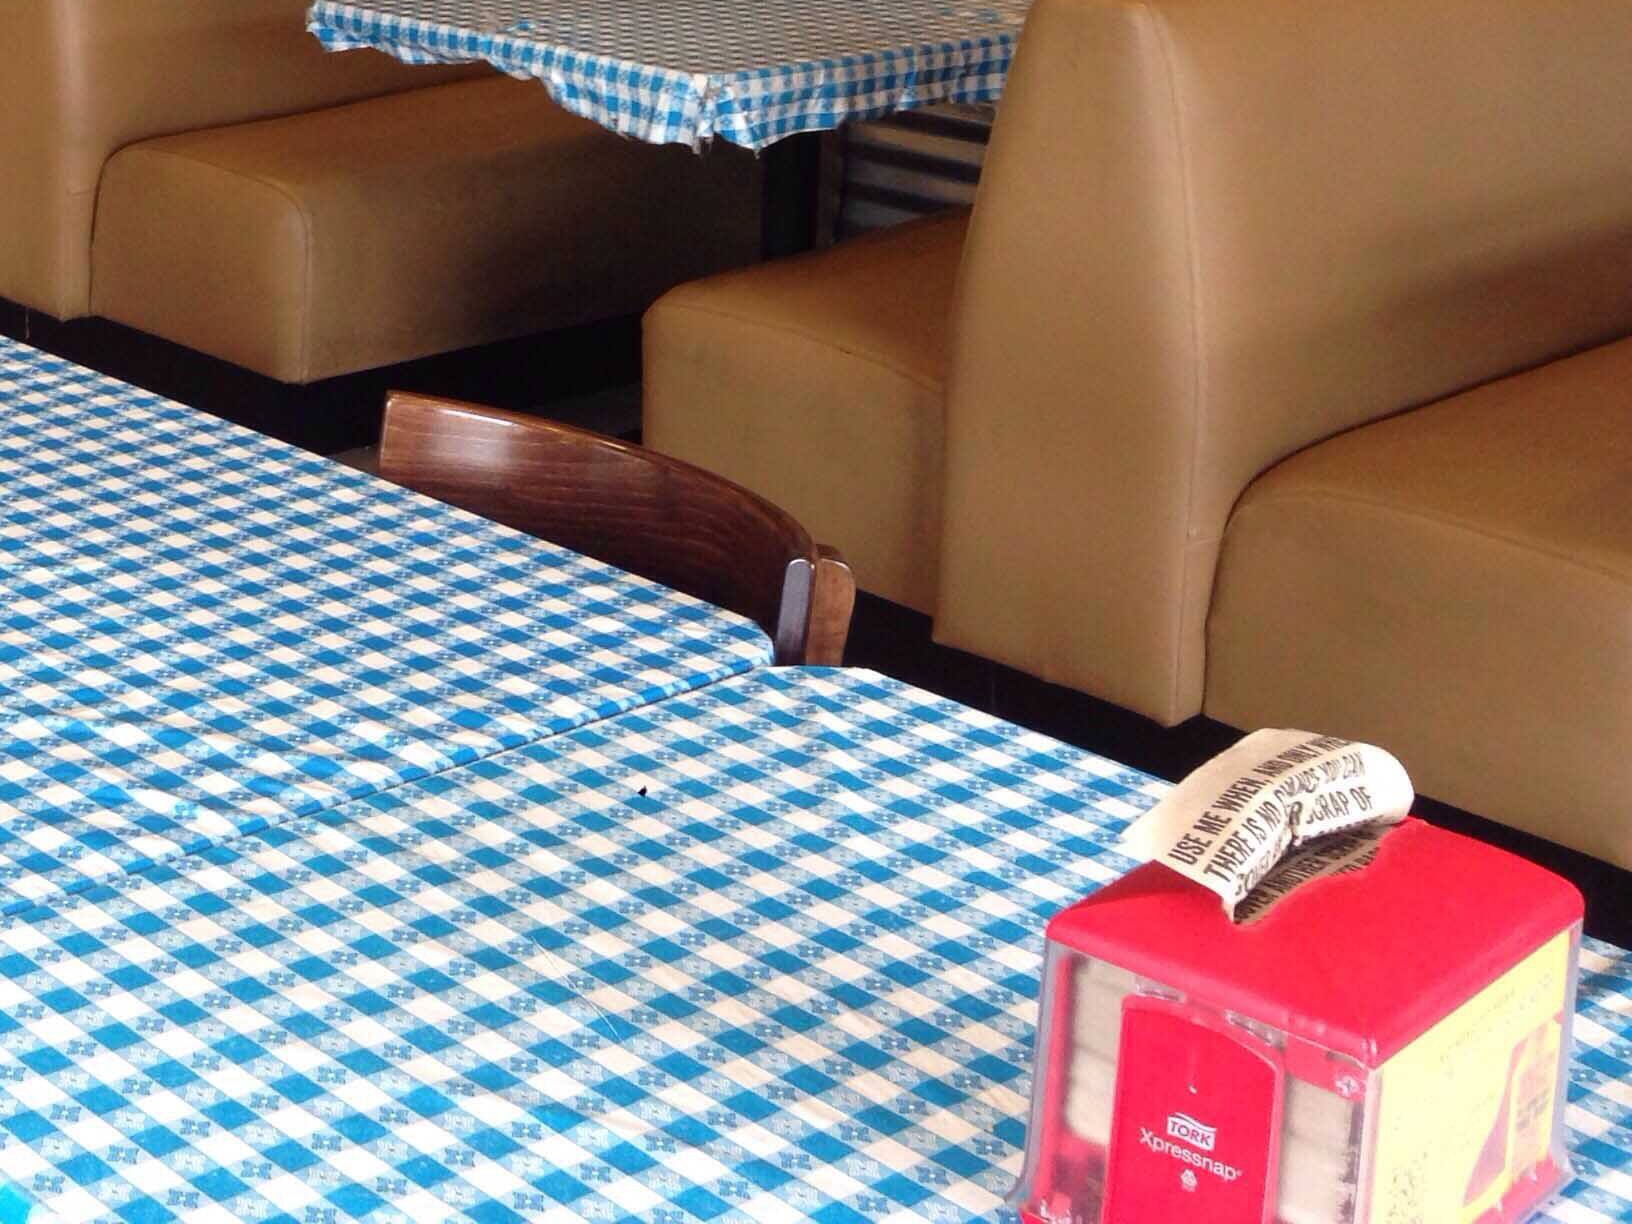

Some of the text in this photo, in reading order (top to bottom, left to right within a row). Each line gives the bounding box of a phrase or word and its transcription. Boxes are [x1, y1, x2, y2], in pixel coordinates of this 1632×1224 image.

[1168, 829, 1213, 866] USE
[1192, 808, 1232, 841] ME
[1252, 759, 1290, 782] AND
[1354, 785, 1374, 812] OF
[1246, 816, 1270, 845] IS
[1255, 798, 1282, 836] NO
[1203, 829, 1256, 883] THERE
[1171, 1120, 1211, 1148] TORK
